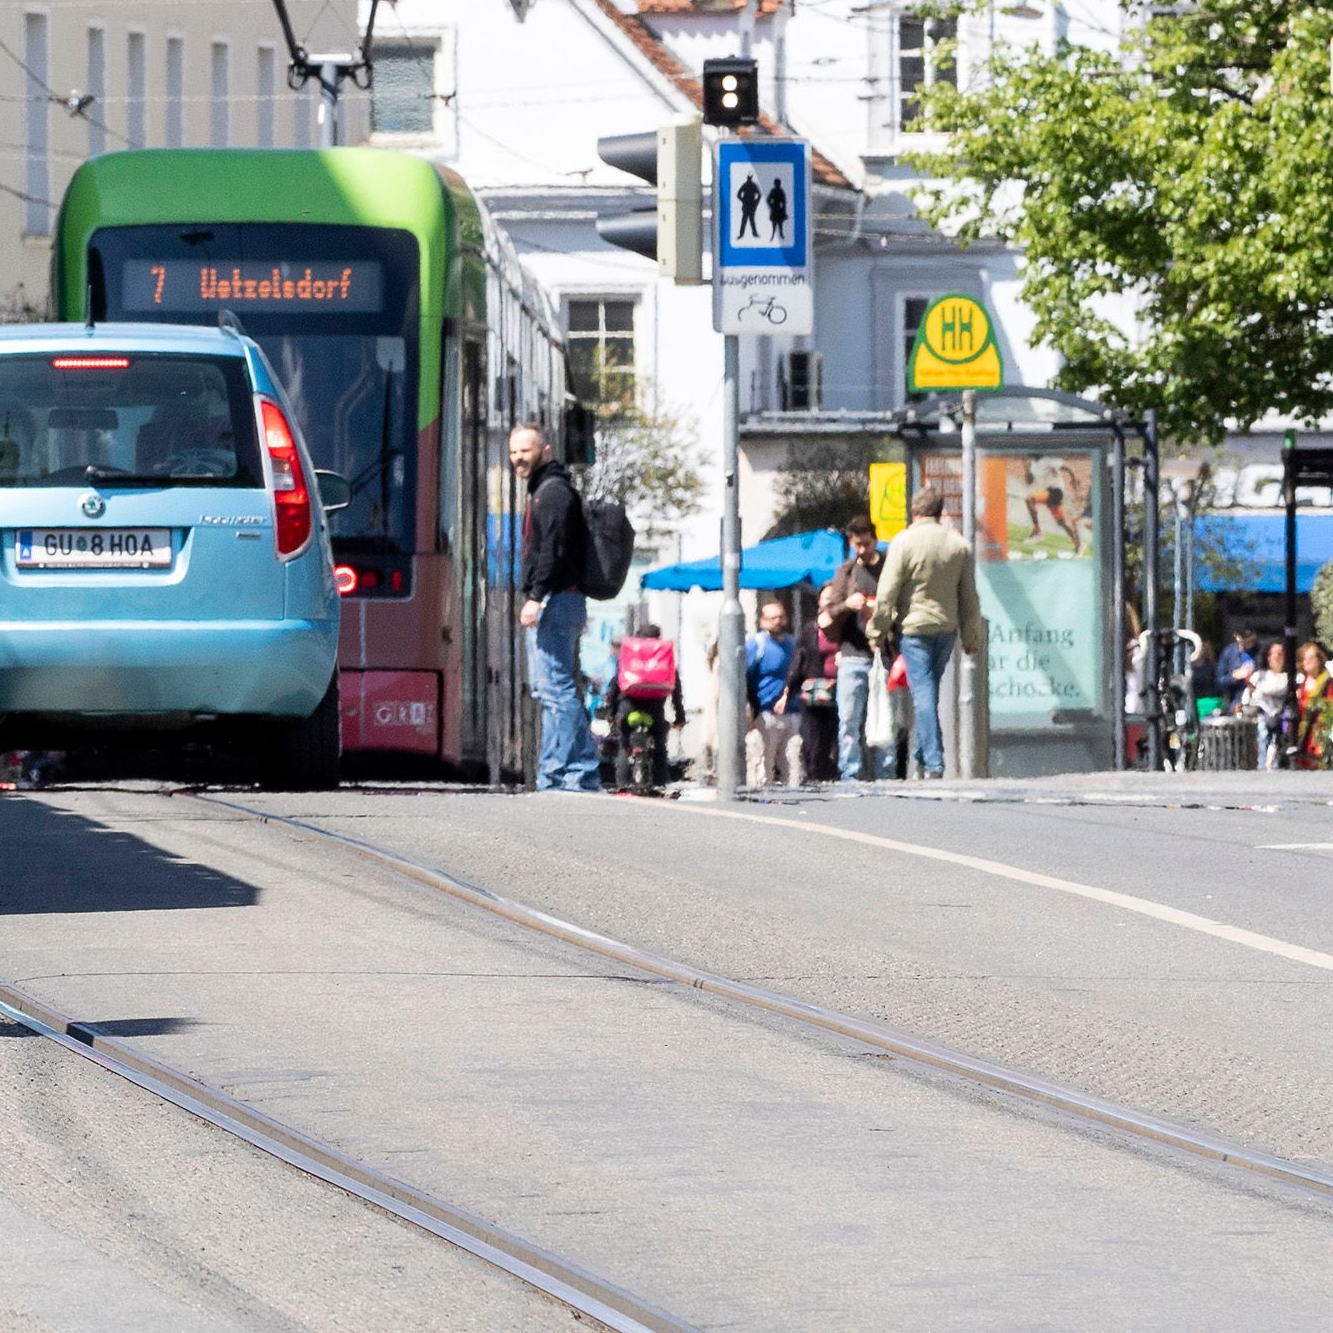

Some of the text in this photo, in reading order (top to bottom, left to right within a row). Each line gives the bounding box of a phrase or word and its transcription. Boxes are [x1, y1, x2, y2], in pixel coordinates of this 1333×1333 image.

[150, 265, 166, 304] 7
[43, 533, 73, 556] GU
[990, 621, 1074, 648] Anfang
